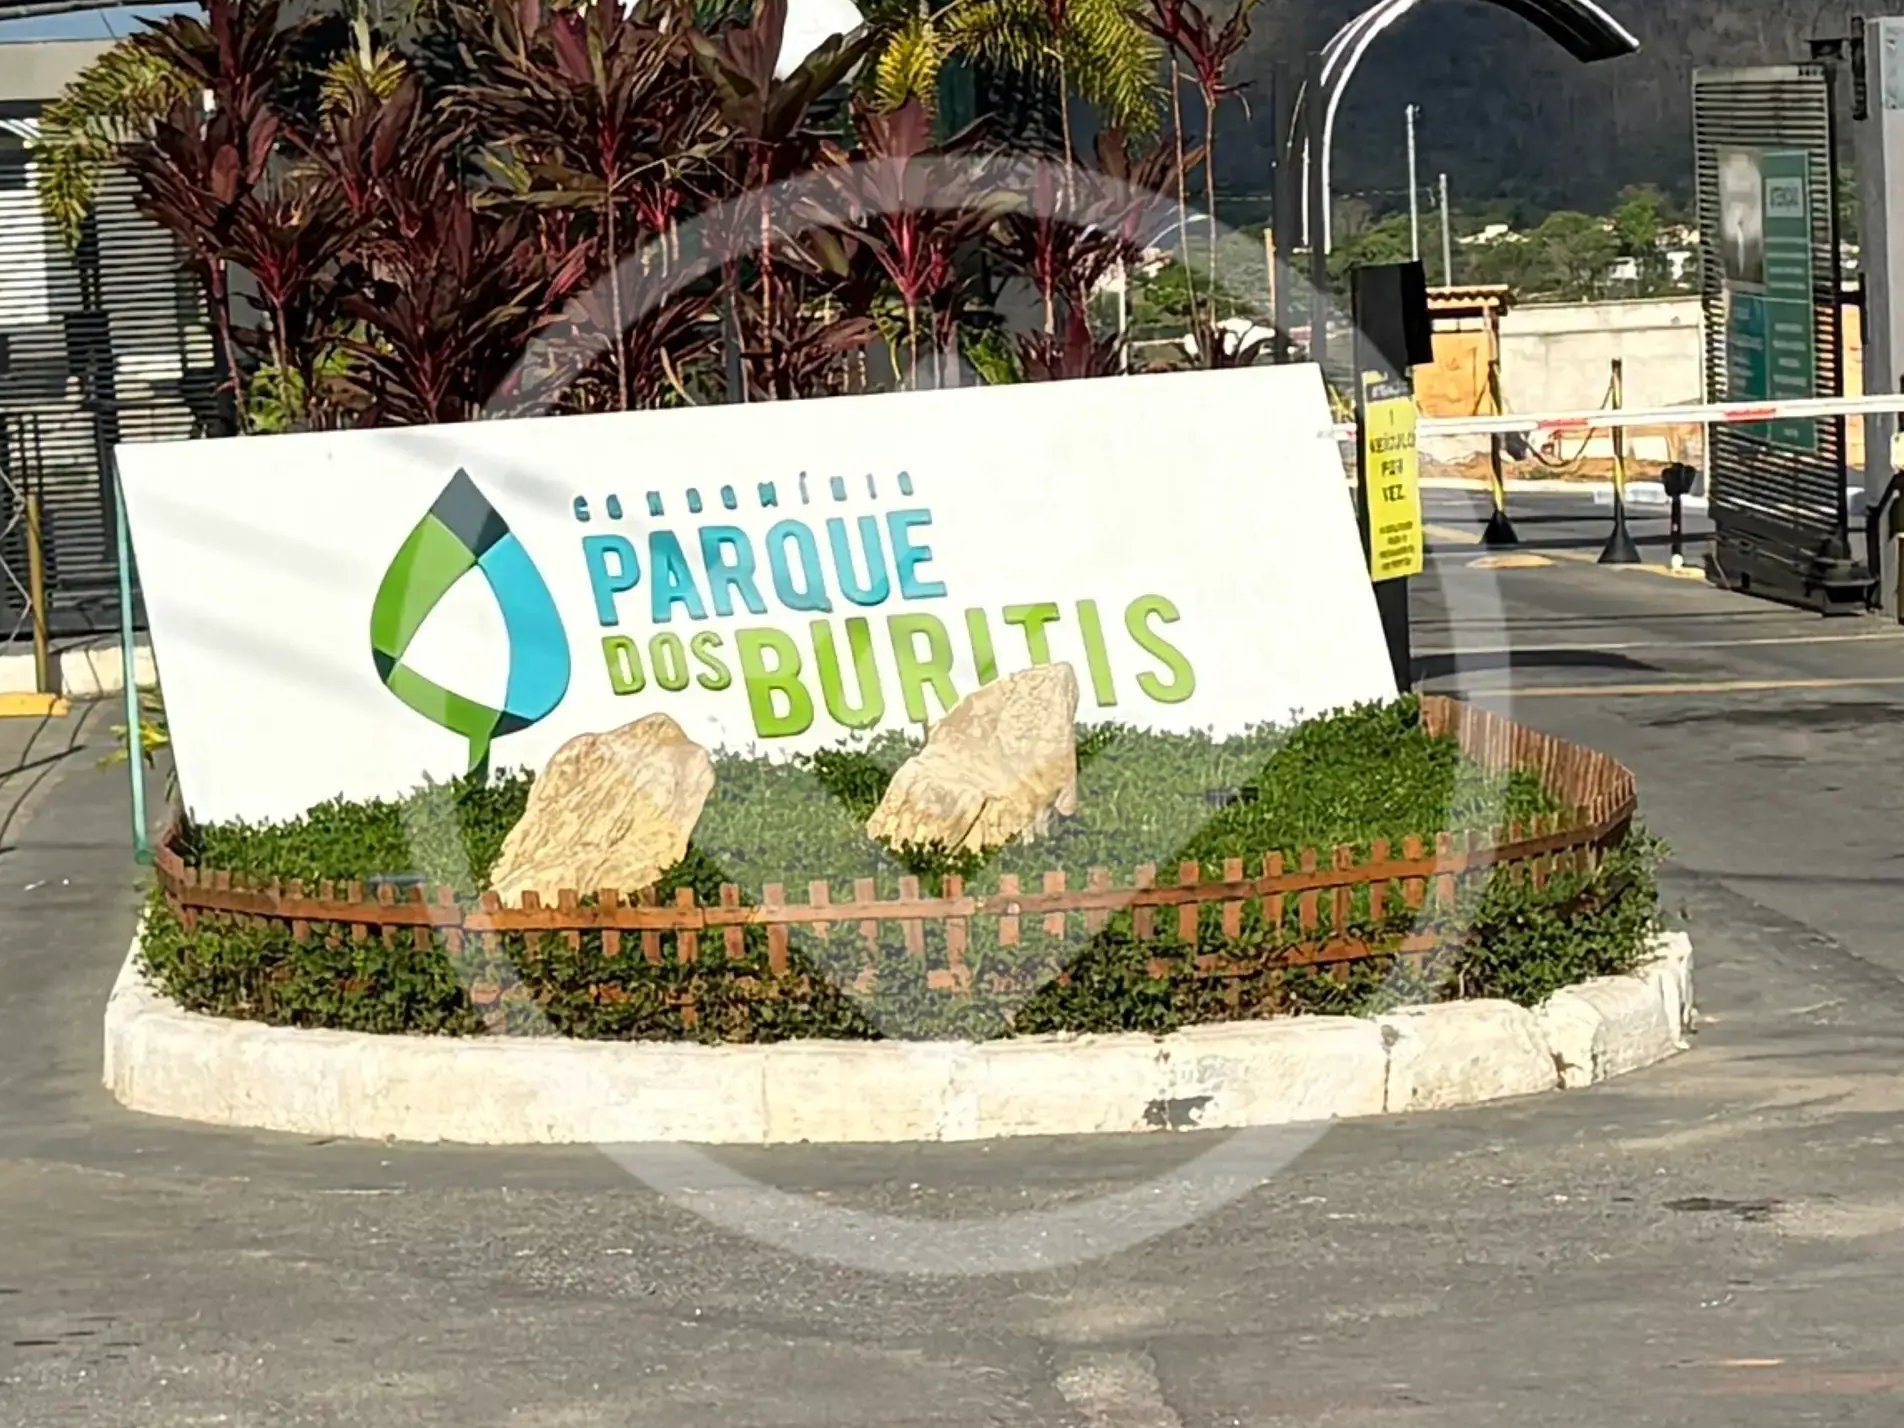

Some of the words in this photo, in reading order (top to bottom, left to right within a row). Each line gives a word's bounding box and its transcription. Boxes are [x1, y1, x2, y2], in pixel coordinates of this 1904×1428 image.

[1369, 432, 1417, 454] VEÍCULO
[573, 469, 914, 522] CONDOMÍNIO
[581, 508, 948, 627] PARQUE
[601, 629, 733, 696] DOS
[734, 593, 1197, 739] BURITIS
